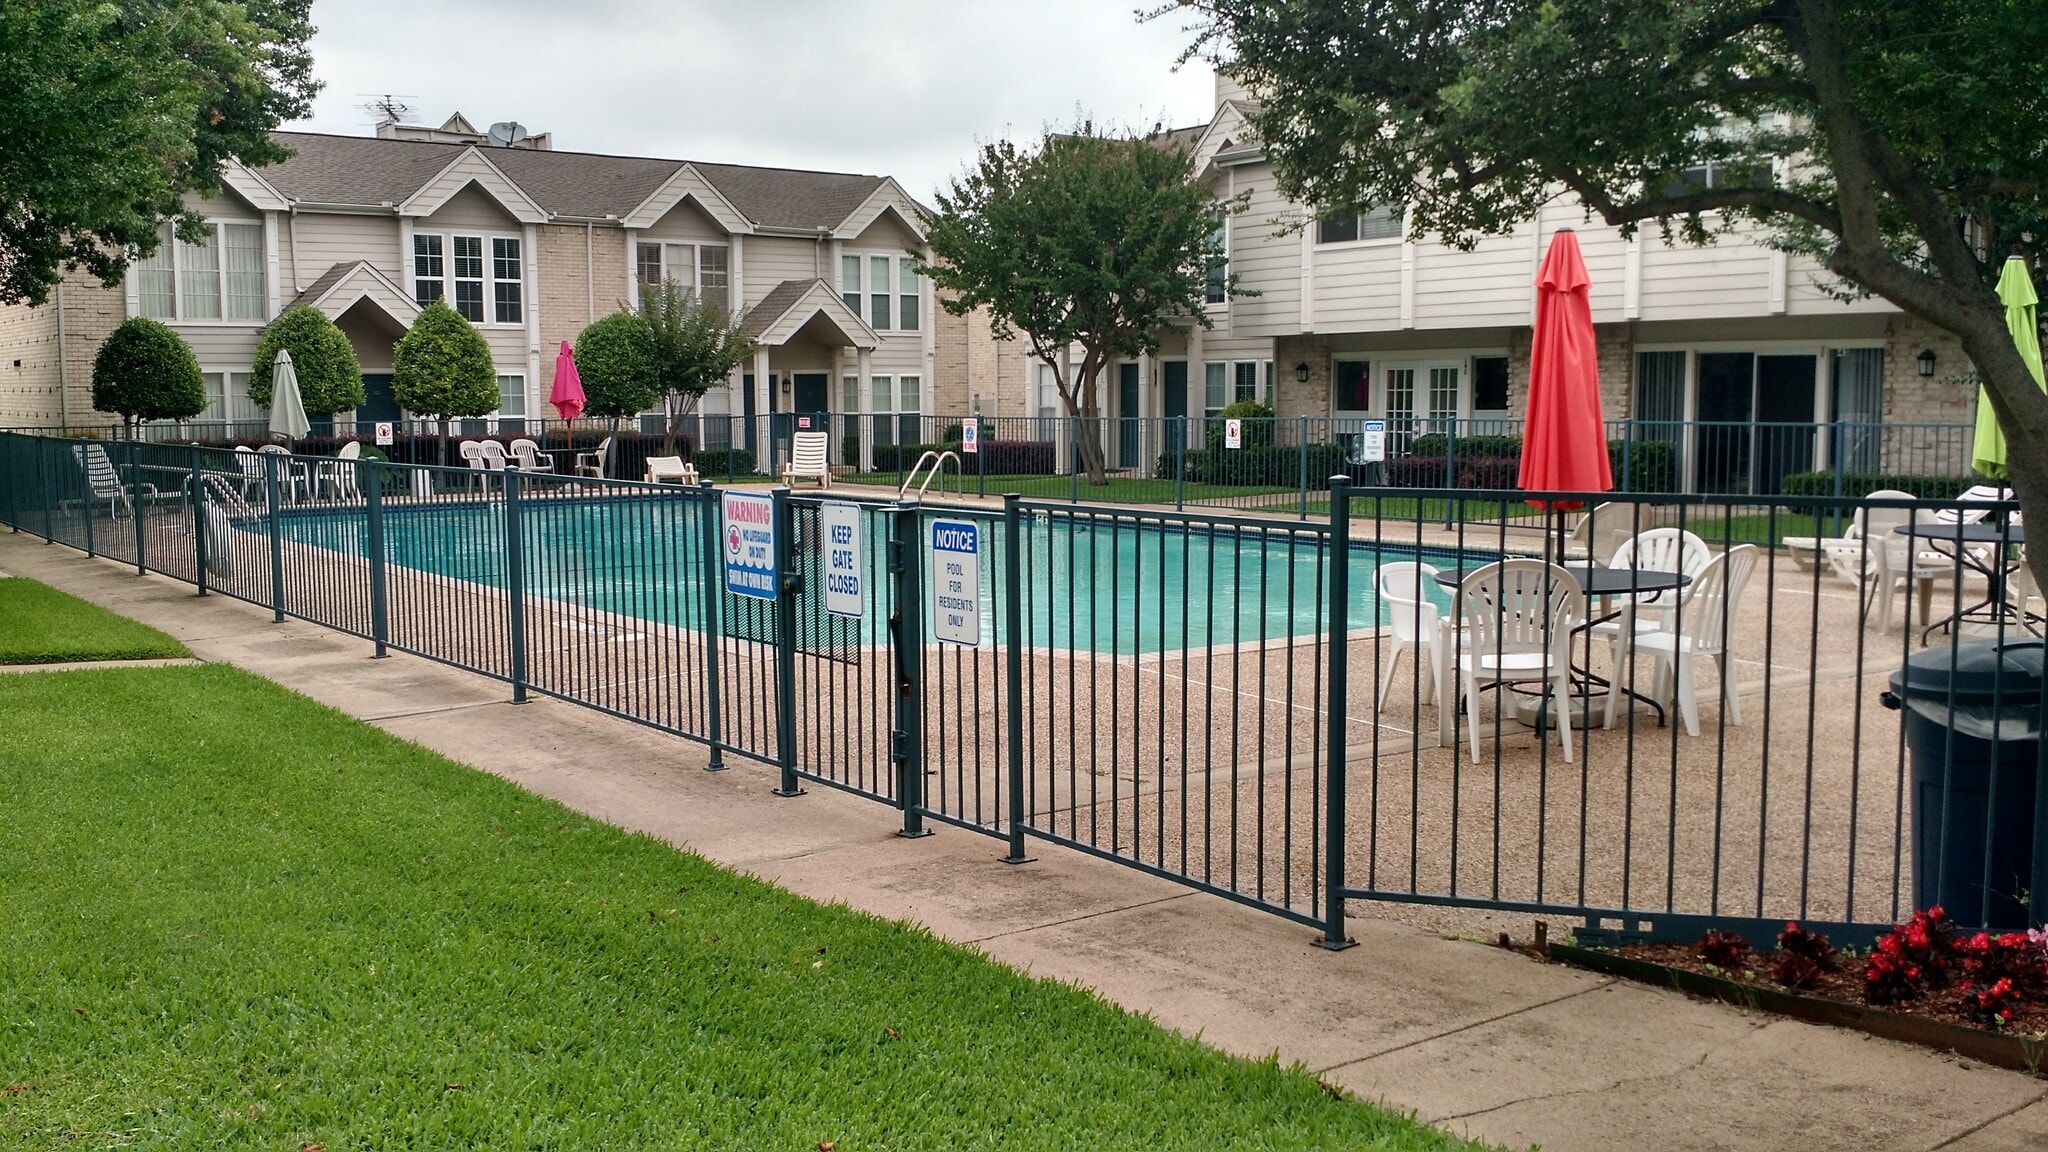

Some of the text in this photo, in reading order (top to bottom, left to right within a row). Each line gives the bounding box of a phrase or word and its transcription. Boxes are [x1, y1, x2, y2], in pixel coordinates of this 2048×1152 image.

[726, 500, 770, 525] WARNING
[743, 529, 771, 545] NO LIFEGUARD
[831, 524, 852, 545] KEEP
[936, 528, 974, 551] NOTICE
[749, 546, 767, 560] ON DUTY
[832, 549, 853, 570] GATE
[947, 563, 964, 576] POOL
[729, 569, 774, 592] SWIM AT OWN RISK
[828, 573, 859, 595] CLOSED
[949, 580, 962, 593] FOR
[939, 596, 973, 612] RESIDENTS
[948, 614, 964, 627] ONLY
